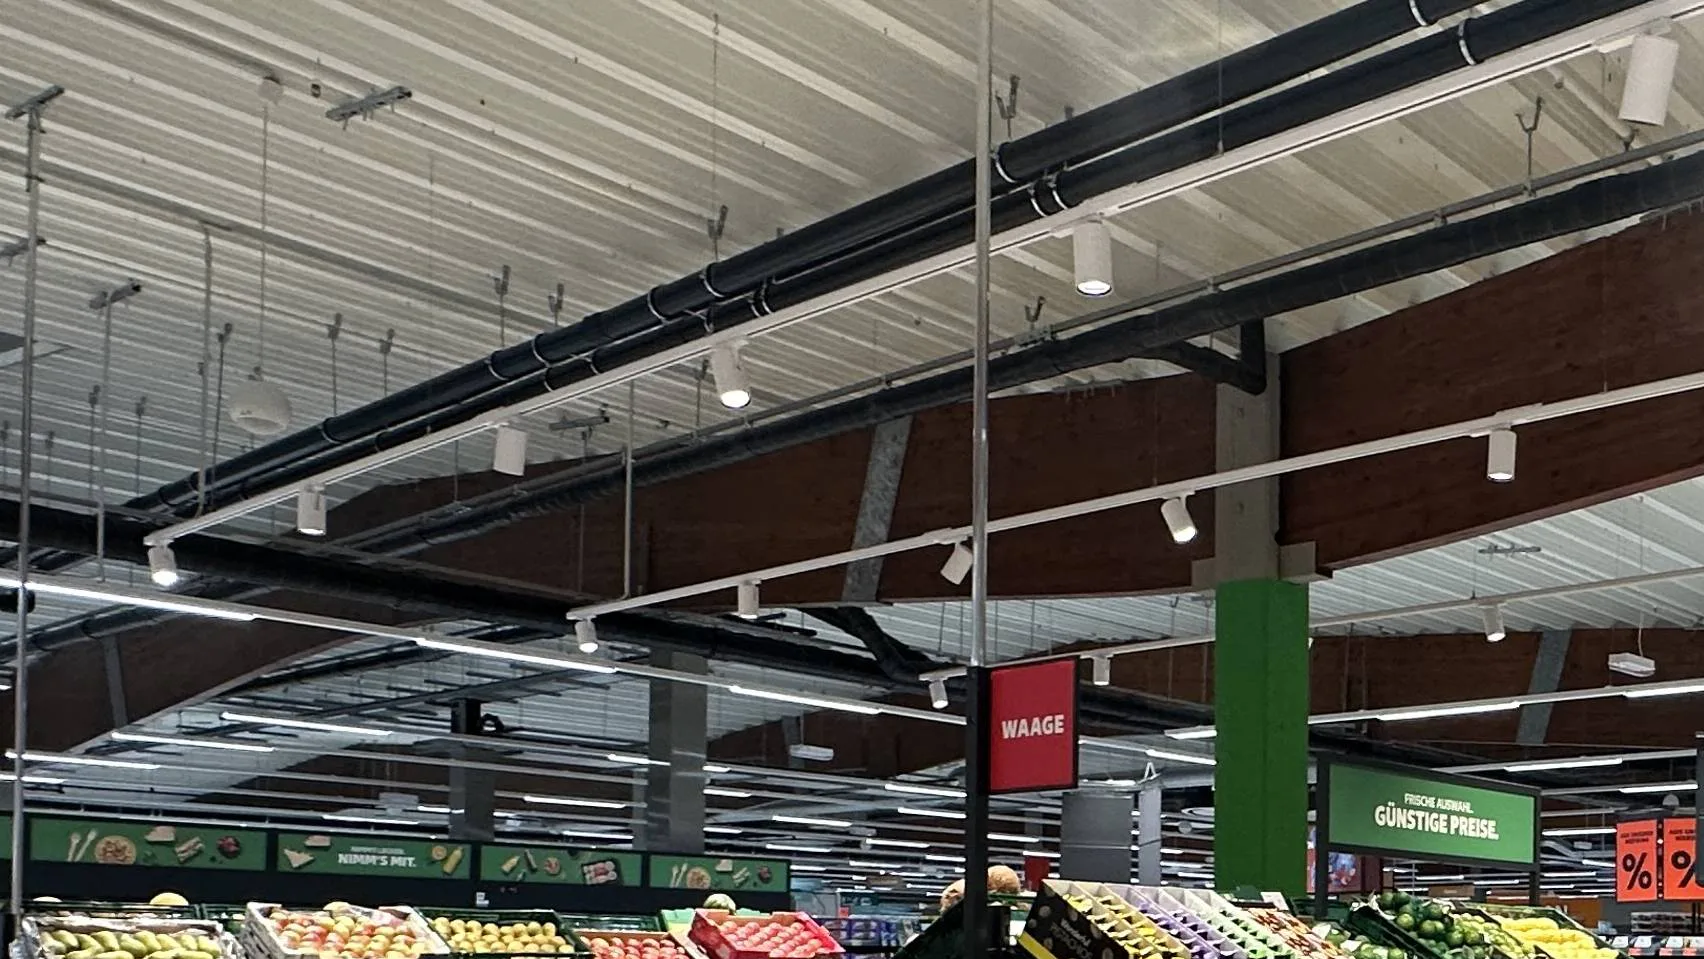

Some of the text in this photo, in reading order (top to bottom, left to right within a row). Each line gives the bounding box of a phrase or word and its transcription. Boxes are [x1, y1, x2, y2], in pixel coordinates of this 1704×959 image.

[1001, 714, 1065, 739] WAAGE
[1404, 793, 1436, 808] FRISCHE
[1374, 801, 1499, 840] GÜNSTIGE PREISE.
[337, 853, 416, 868] NIMM'S MIT.
[1622, 852, 1652, 890] %
